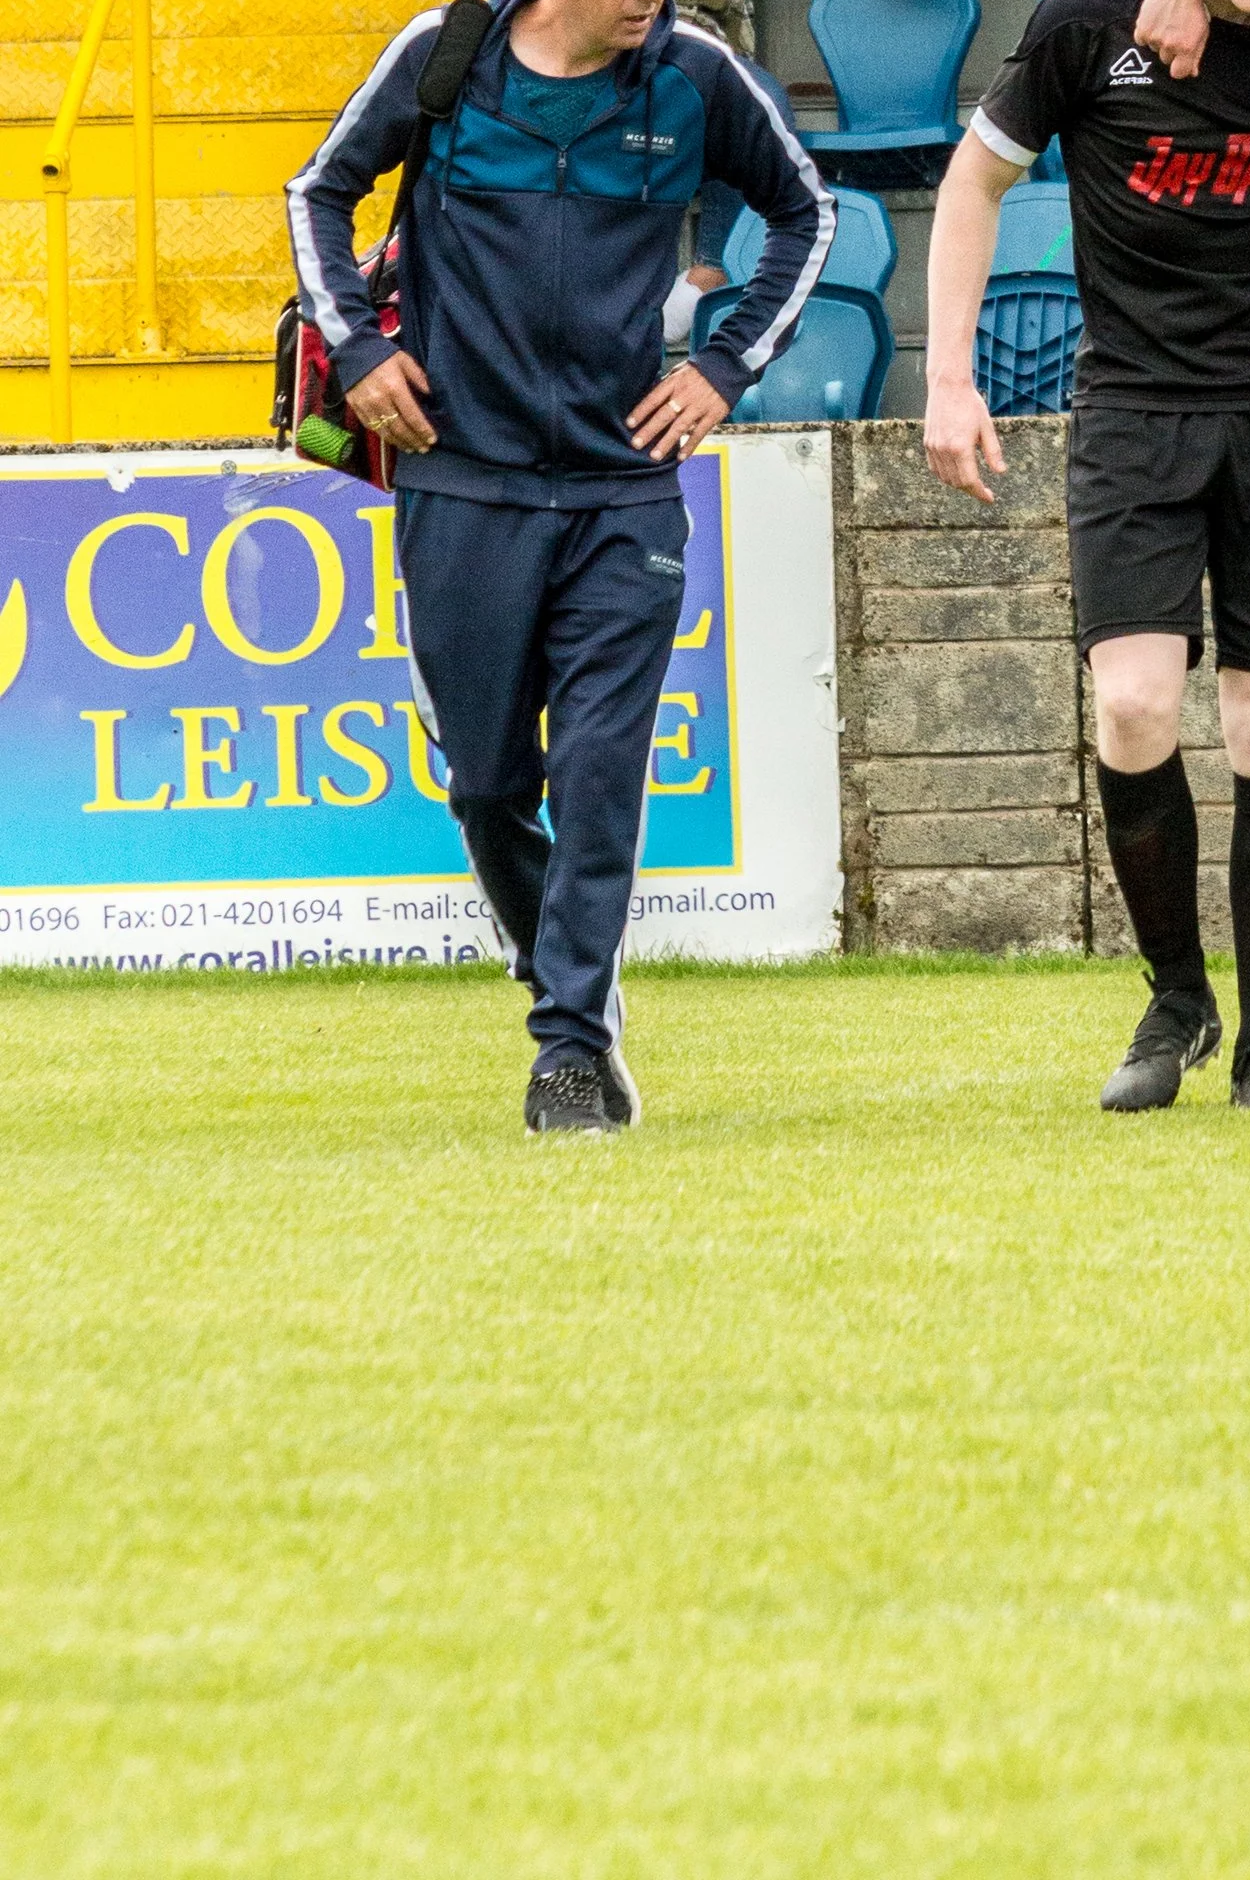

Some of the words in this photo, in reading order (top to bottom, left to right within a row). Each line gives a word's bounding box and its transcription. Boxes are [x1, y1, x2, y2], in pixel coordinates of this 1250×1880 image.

[103, 904, 156, 929] Fax:
[161, 898, 344, 928] 021-4201694
[366, 893, 458, 921] E-mail:
